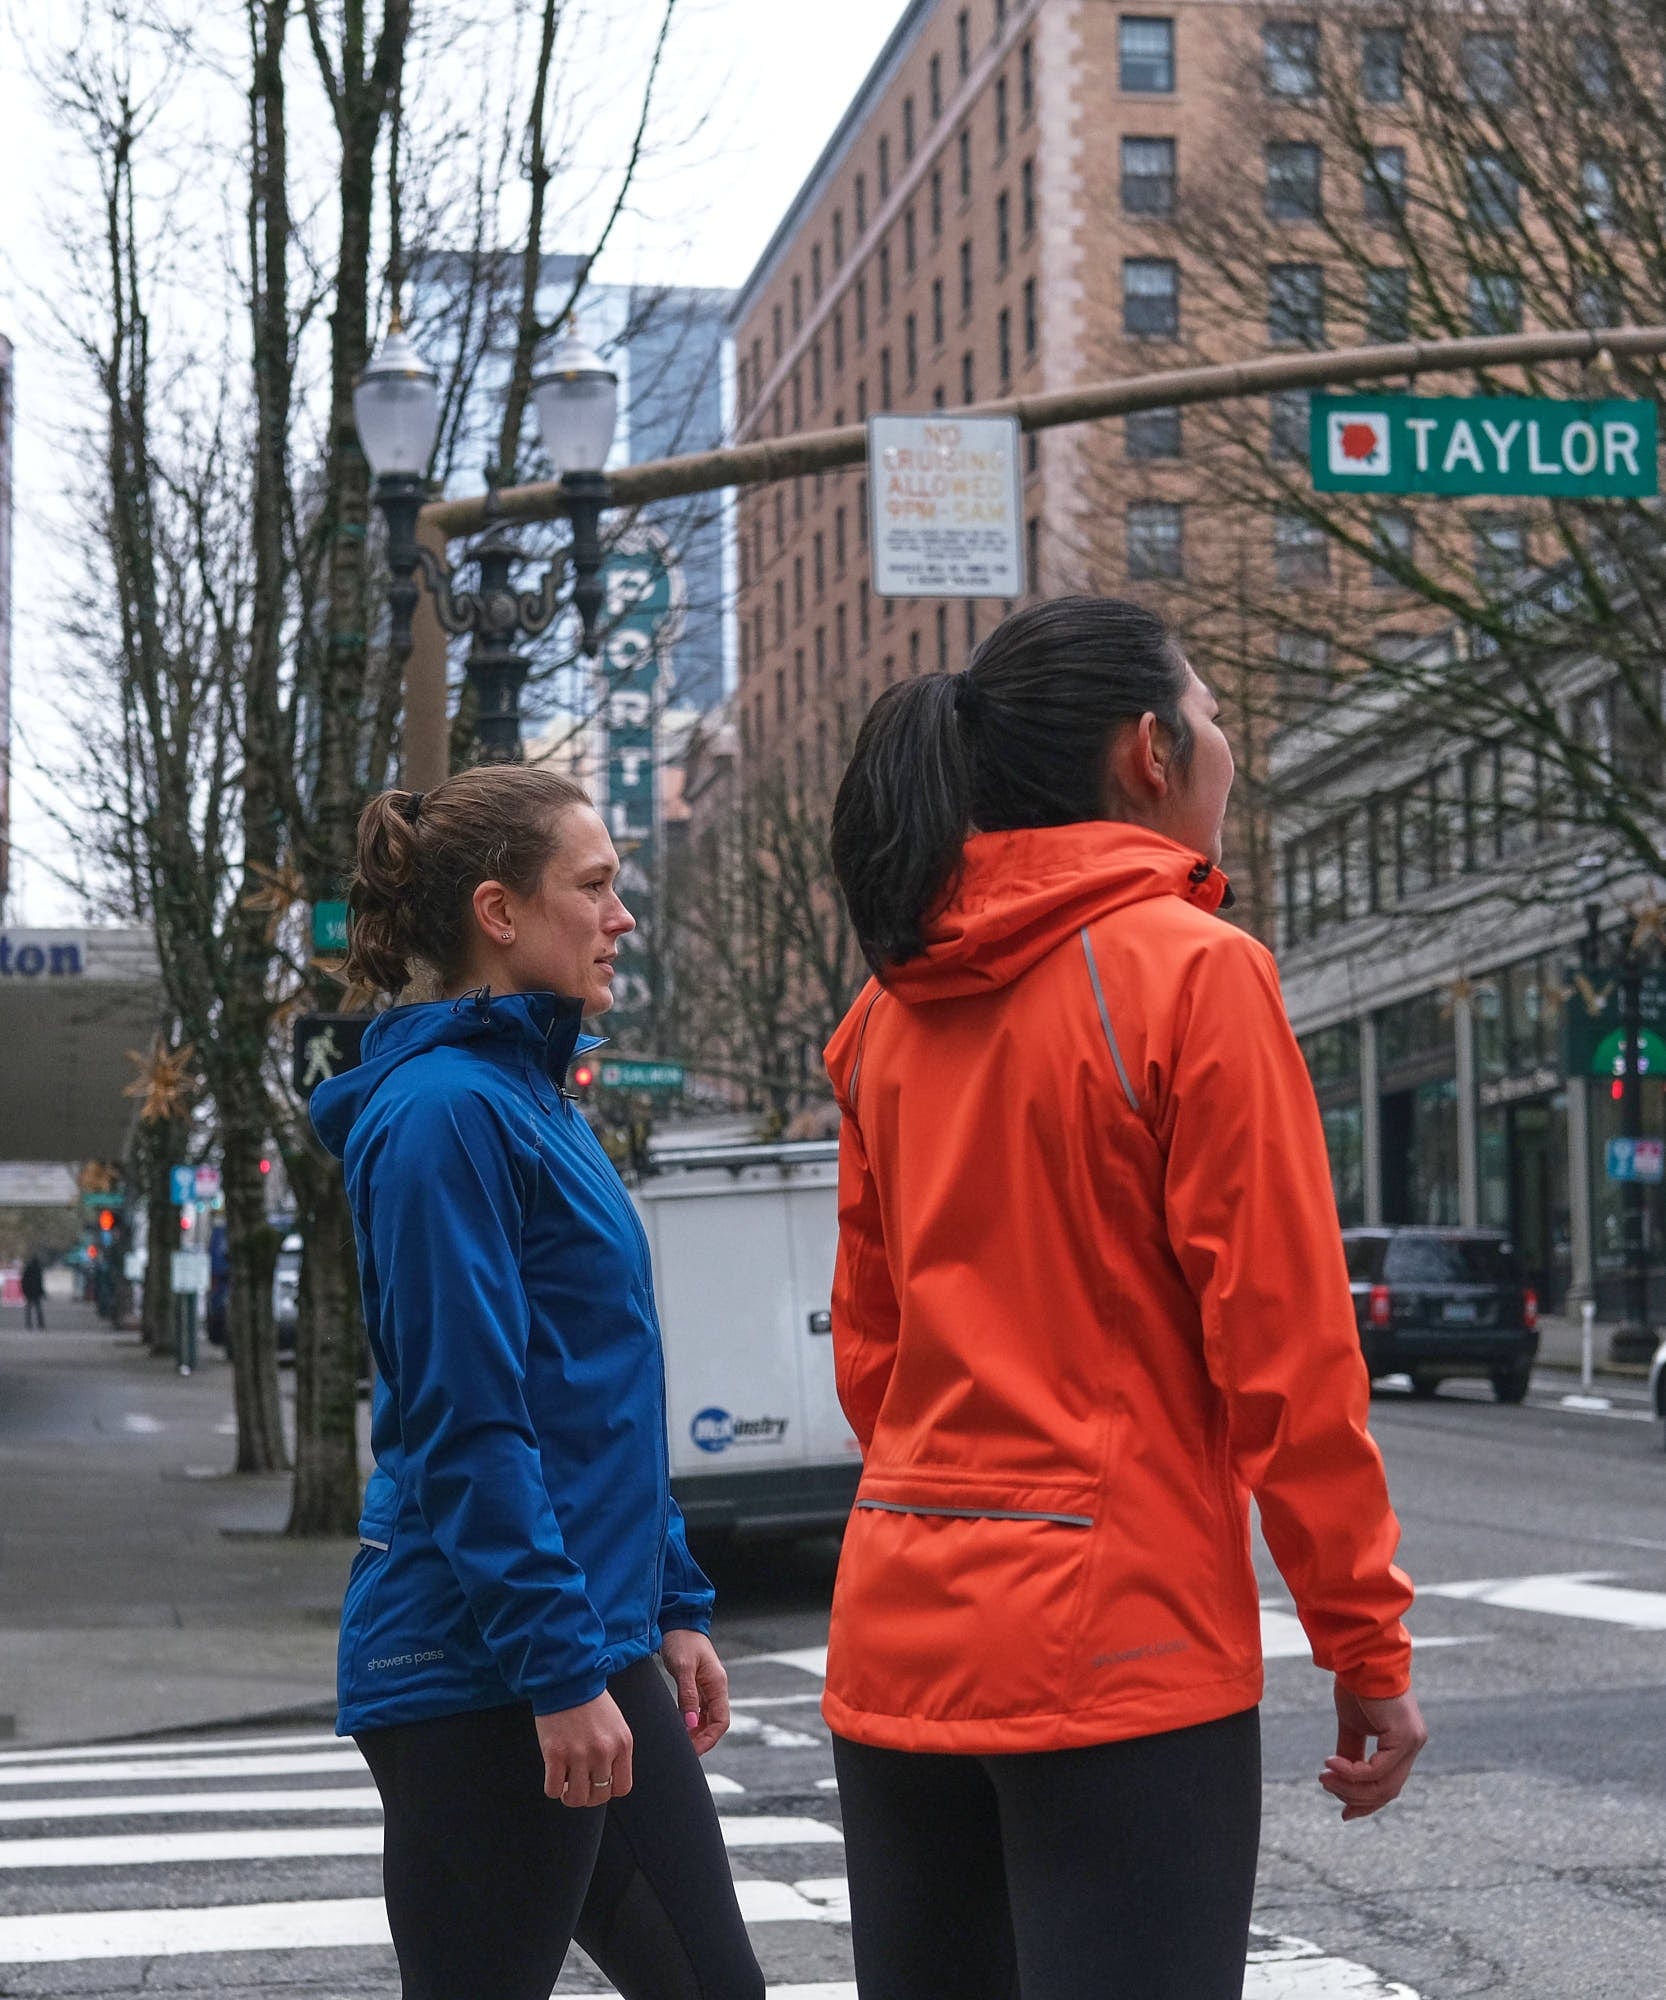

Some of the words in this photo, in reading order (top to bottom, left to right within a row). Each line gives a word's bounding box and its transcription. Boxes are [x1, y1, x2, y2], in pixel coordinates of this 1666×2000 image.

[924, 424, 962, 446] NO
[1405, 418, 1640, 476] TAYLOR
[889, 475, 1004, 499] ALLOWED
[367, 1654, 412, 1671] showers
[415, 1649, 444, 1666] pass
